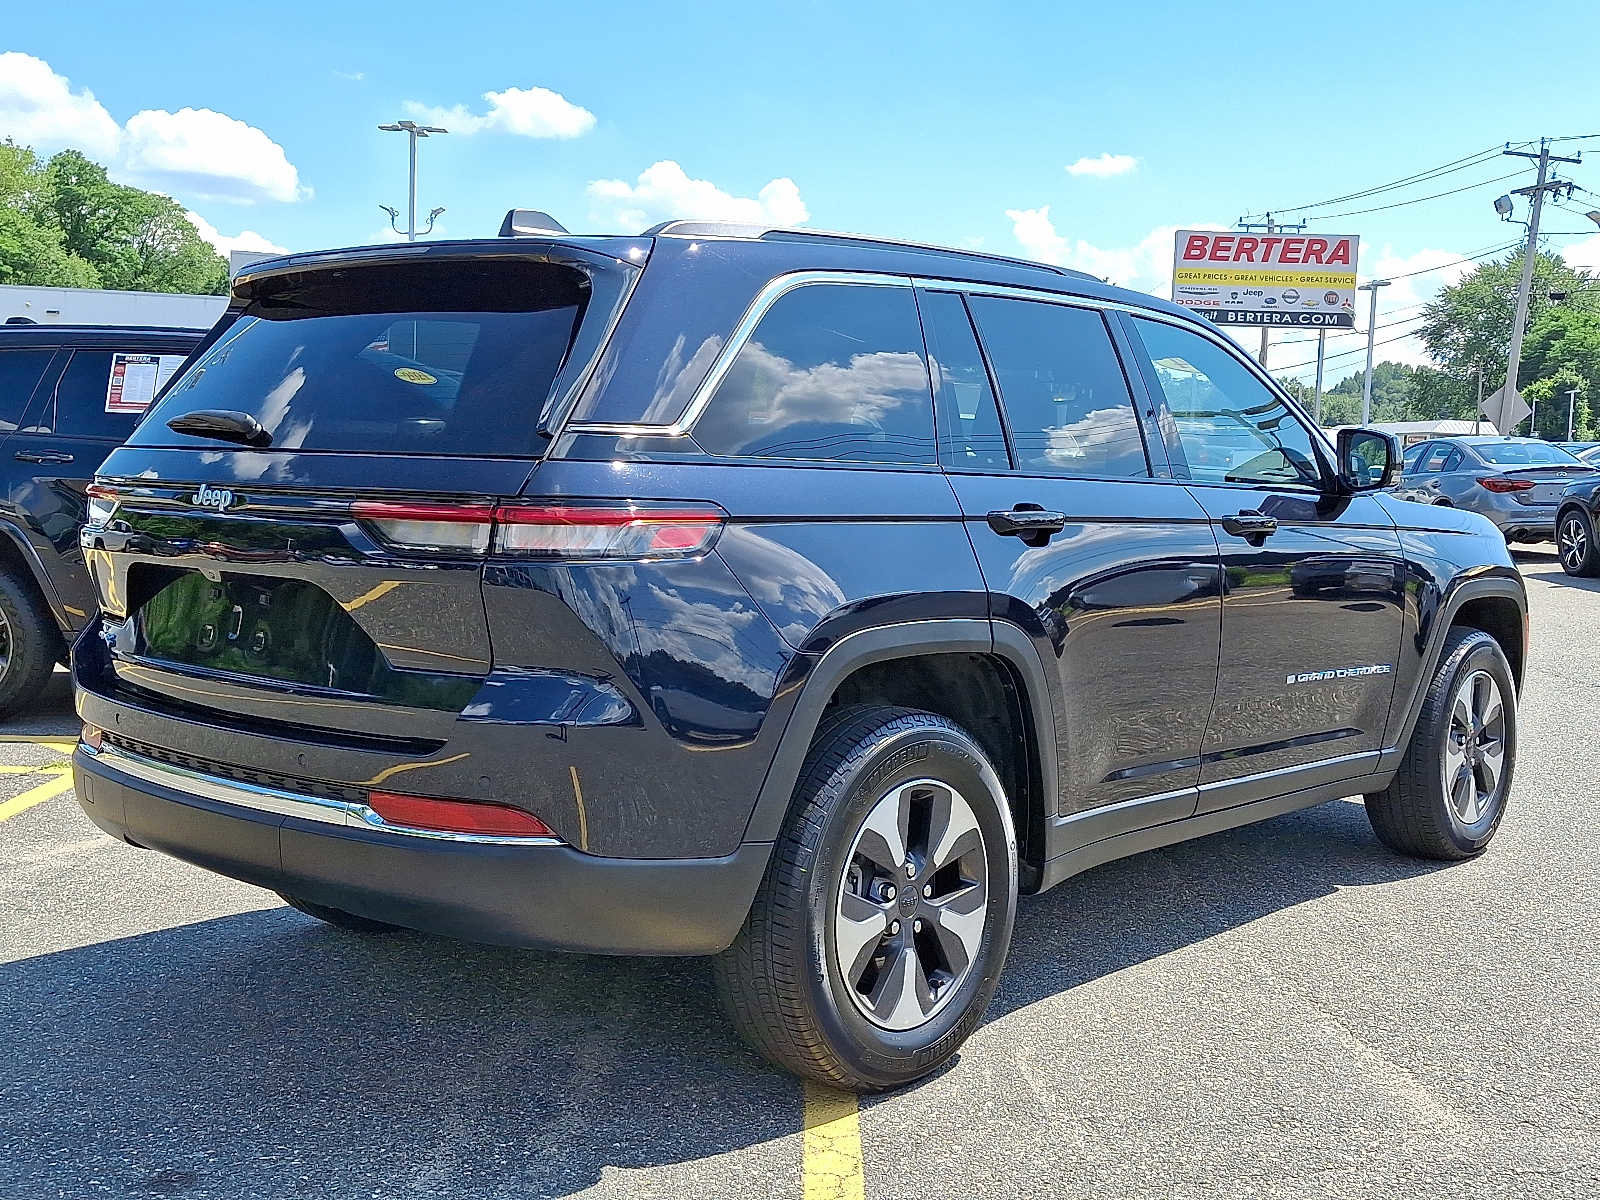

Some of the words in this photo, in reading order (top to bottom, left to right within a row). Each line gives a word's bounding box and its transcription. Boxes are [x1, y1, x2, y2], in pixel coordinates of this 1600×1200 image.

[1183, 235, 1351, 265] BERTERA
[1178, 272, 1201, 280] GREAT
[1203, 273, 1228, 281] PRICES
[1234, 274, 1257, 282] GREAT
[1242, 288, 1264, 298] Jeep
[1227, 311, 1338, 325] BERTERA.COM
[192, 483, 232, 512] Jeep
[1298, 671, 1335, 682] GRAND
[1337, 665, 1390, 677] CHEROKEE
